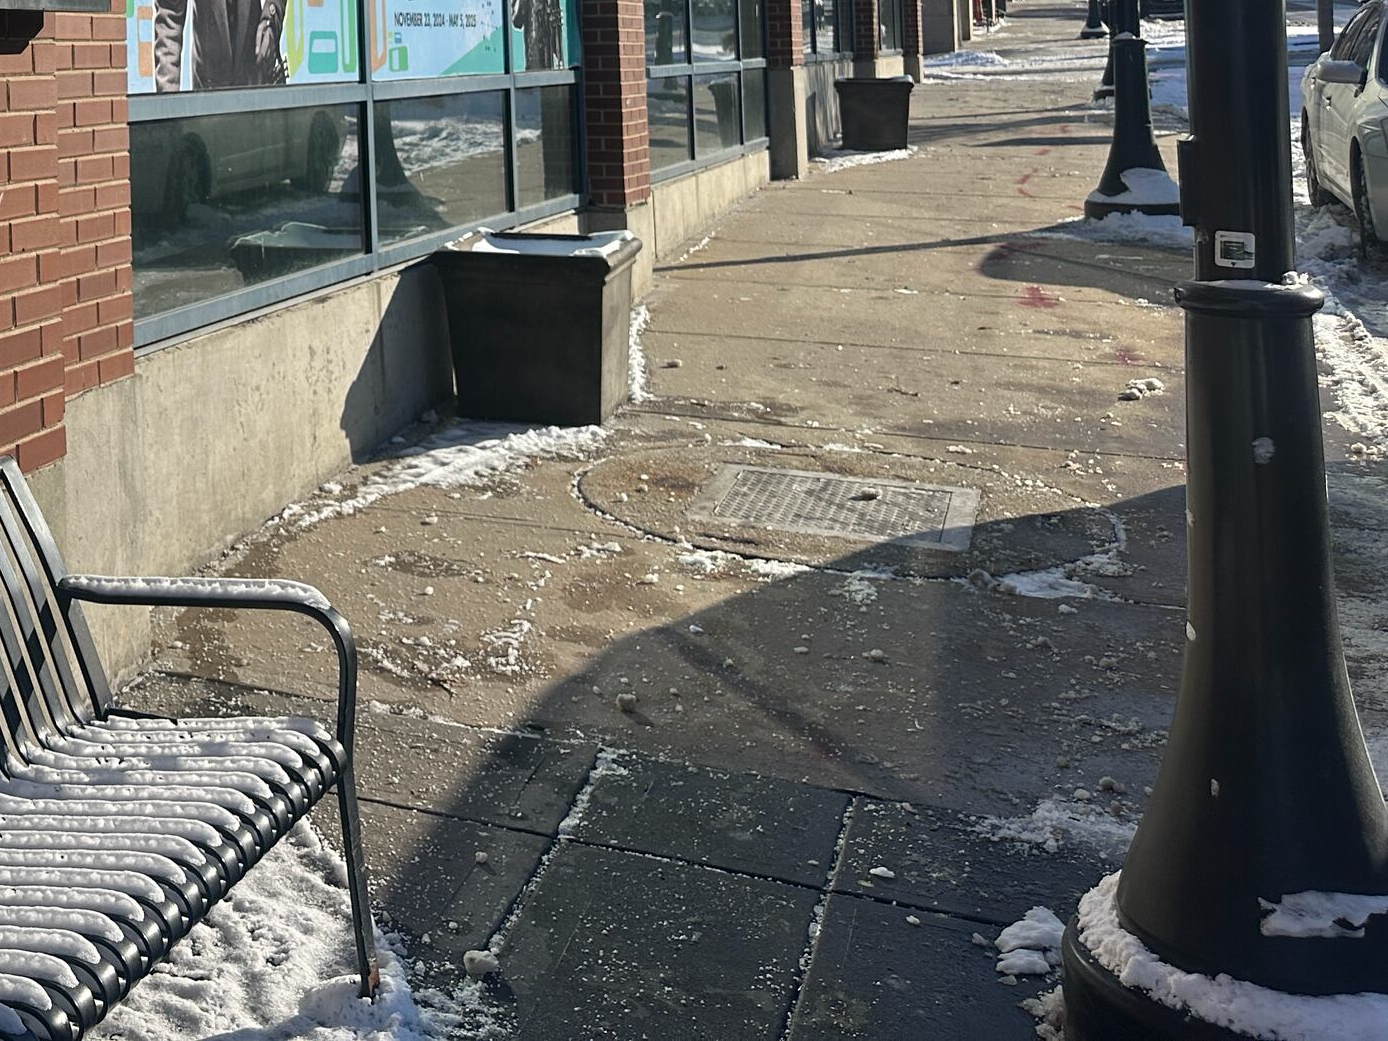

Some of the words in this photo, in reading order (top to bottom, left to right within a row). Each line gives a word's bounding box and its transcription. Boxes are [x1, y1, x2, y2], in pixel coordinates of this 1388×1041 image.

[394, 12, 423, 27] NOVEMBER
[433, 13, 445, 27] 2024
[449, 13, 459, 27] MAY
[466, 14, 477, 27] 2025
